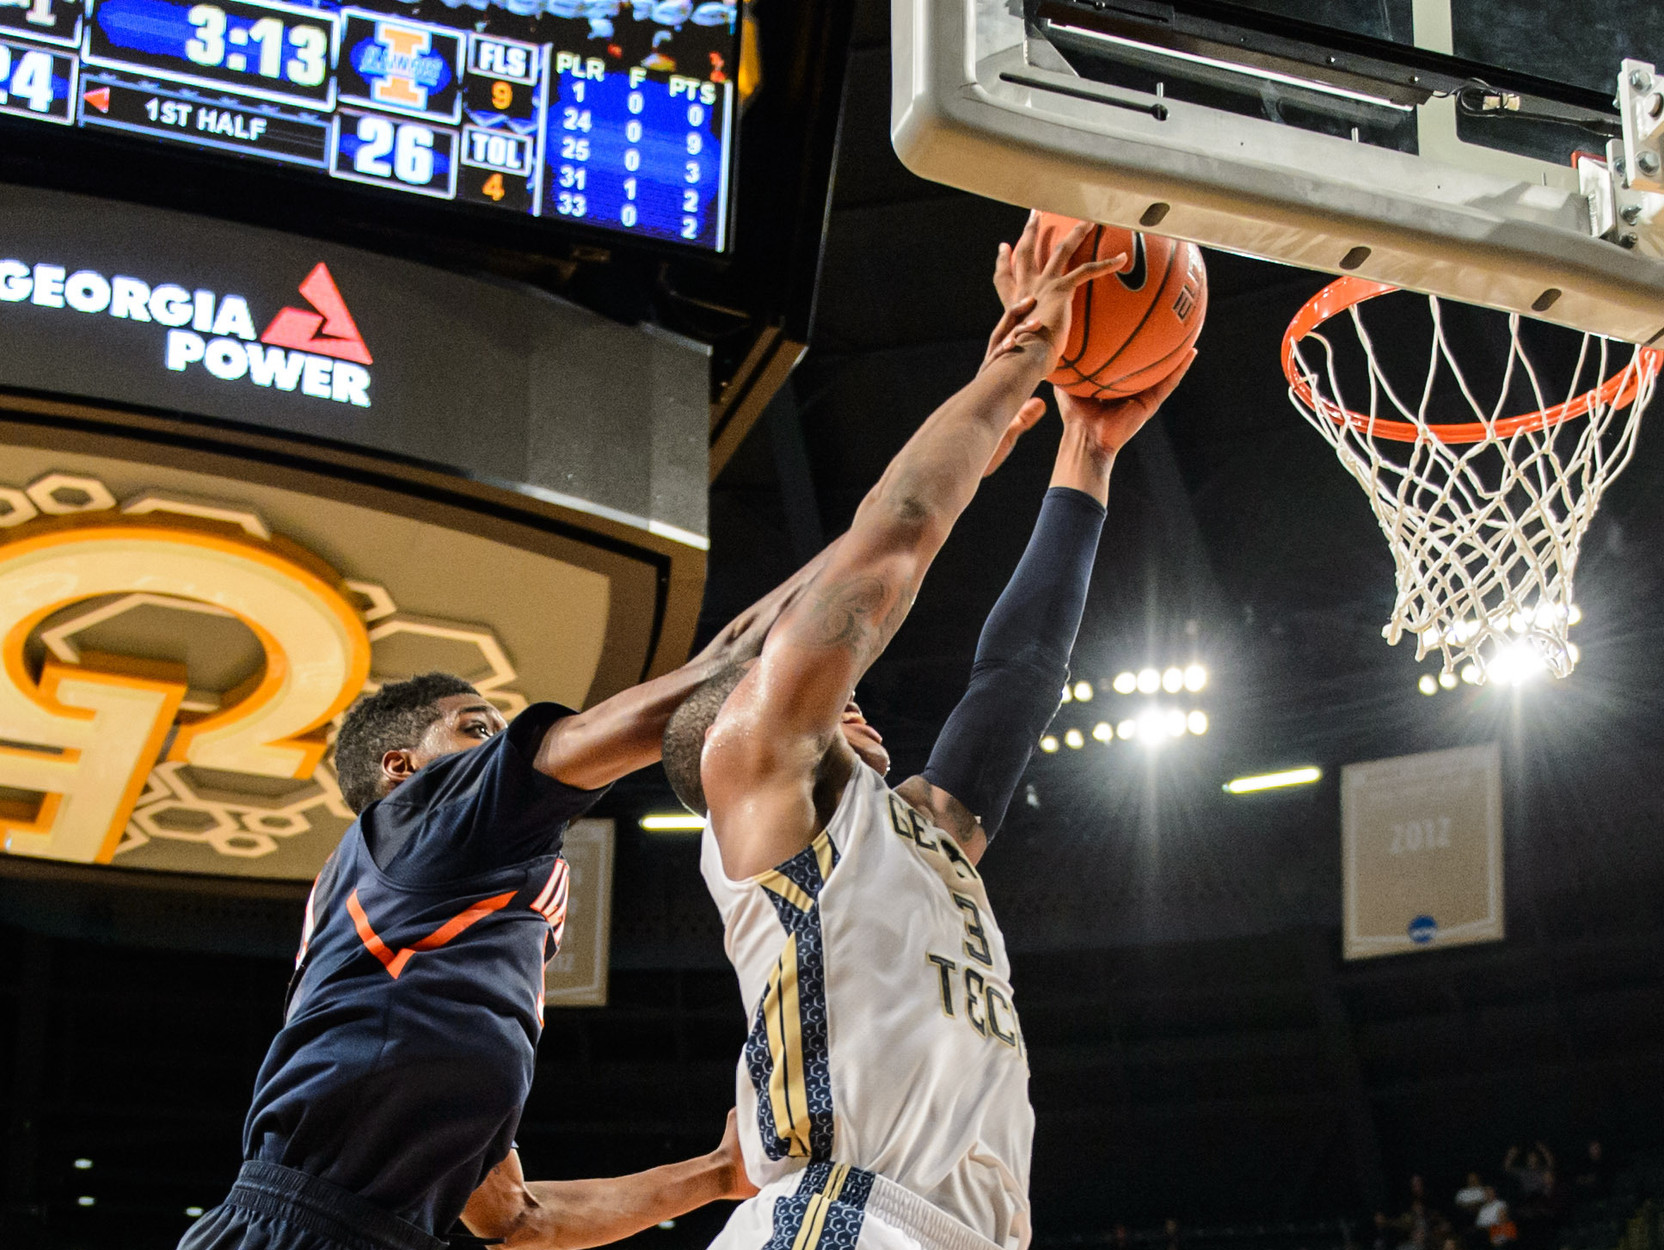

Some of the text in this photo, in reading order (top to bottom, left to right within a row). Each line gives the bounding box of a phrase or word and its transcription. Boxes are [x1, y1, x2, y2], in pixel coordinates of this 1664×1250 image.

[185, 4, 327, 87] 3:13
[478, 41, 527, 78] FLS
[0, 45, 54, 113] 4
[492, 81, 513, 110] 9
[556, 51, 716, 105] PLR F PTS
[145, 97, 267, 141] 1ST HALF
[572, 81, 704, 127] 1 0 0
[354, 116, 434, 185] 26
[471, 132, 522, 169] TOL
[562, 107, 703, 155] 24 0 9
[561, 136, 700, 184] 25 0 3
[482, 173, 505, 201] 4
[559, 164, 699, 213] 31 1 2
[556, 191, 698, 240] 33 0 2
[0, 259, 257, 340] GEORGIA
[165, 329, 372, 408] POWER
[953, 893, 993, 968] 3
